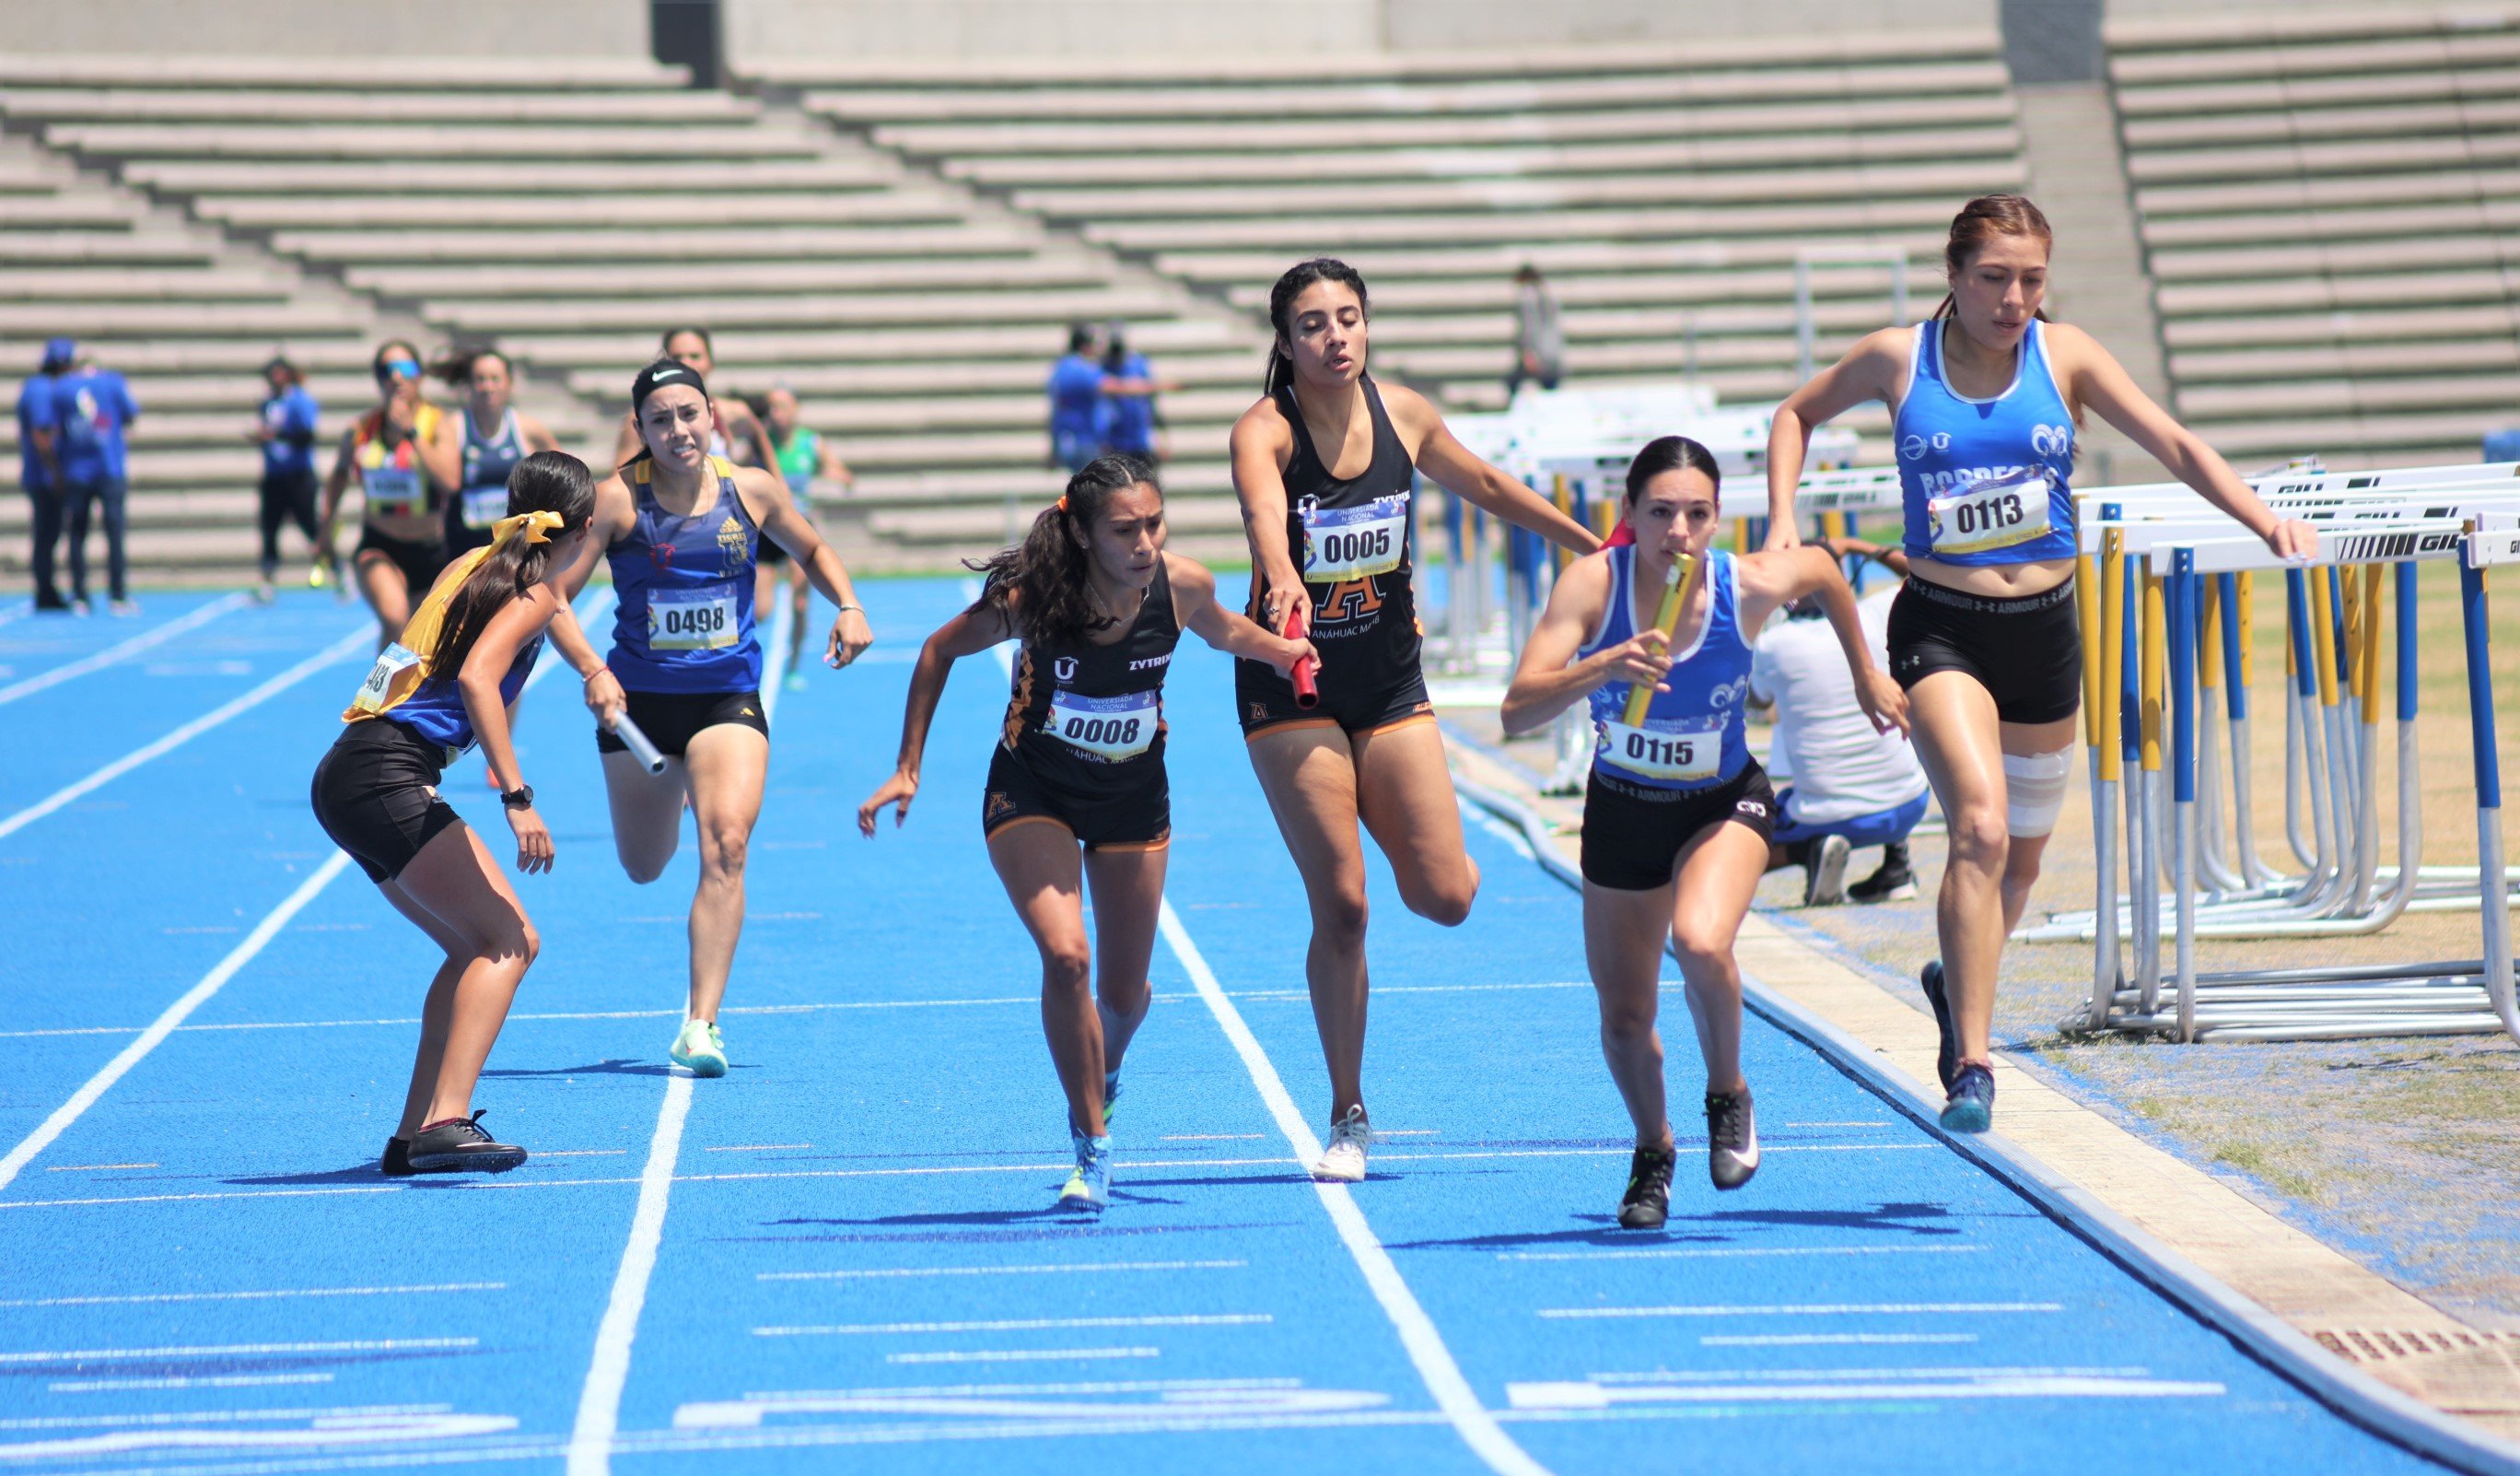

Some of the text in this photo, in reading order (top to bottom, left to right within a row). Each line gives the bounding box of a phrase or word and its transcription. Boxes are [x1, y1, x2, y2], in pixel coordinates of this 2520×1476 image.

[1919, 465, 2059, 498] BORRES
[1957, 494, 2024, 534] 0113
[1324, 528, 1390, 564] 0005
[2419, 533, 2462, 552] GIL
[666, 606, 724, 634] 0498
[1087, 696, 1134, 704] UNIVERSIADA
[1065, 717, 1140, 744] 0008
[1627, 732, 1694, 766] 0115
